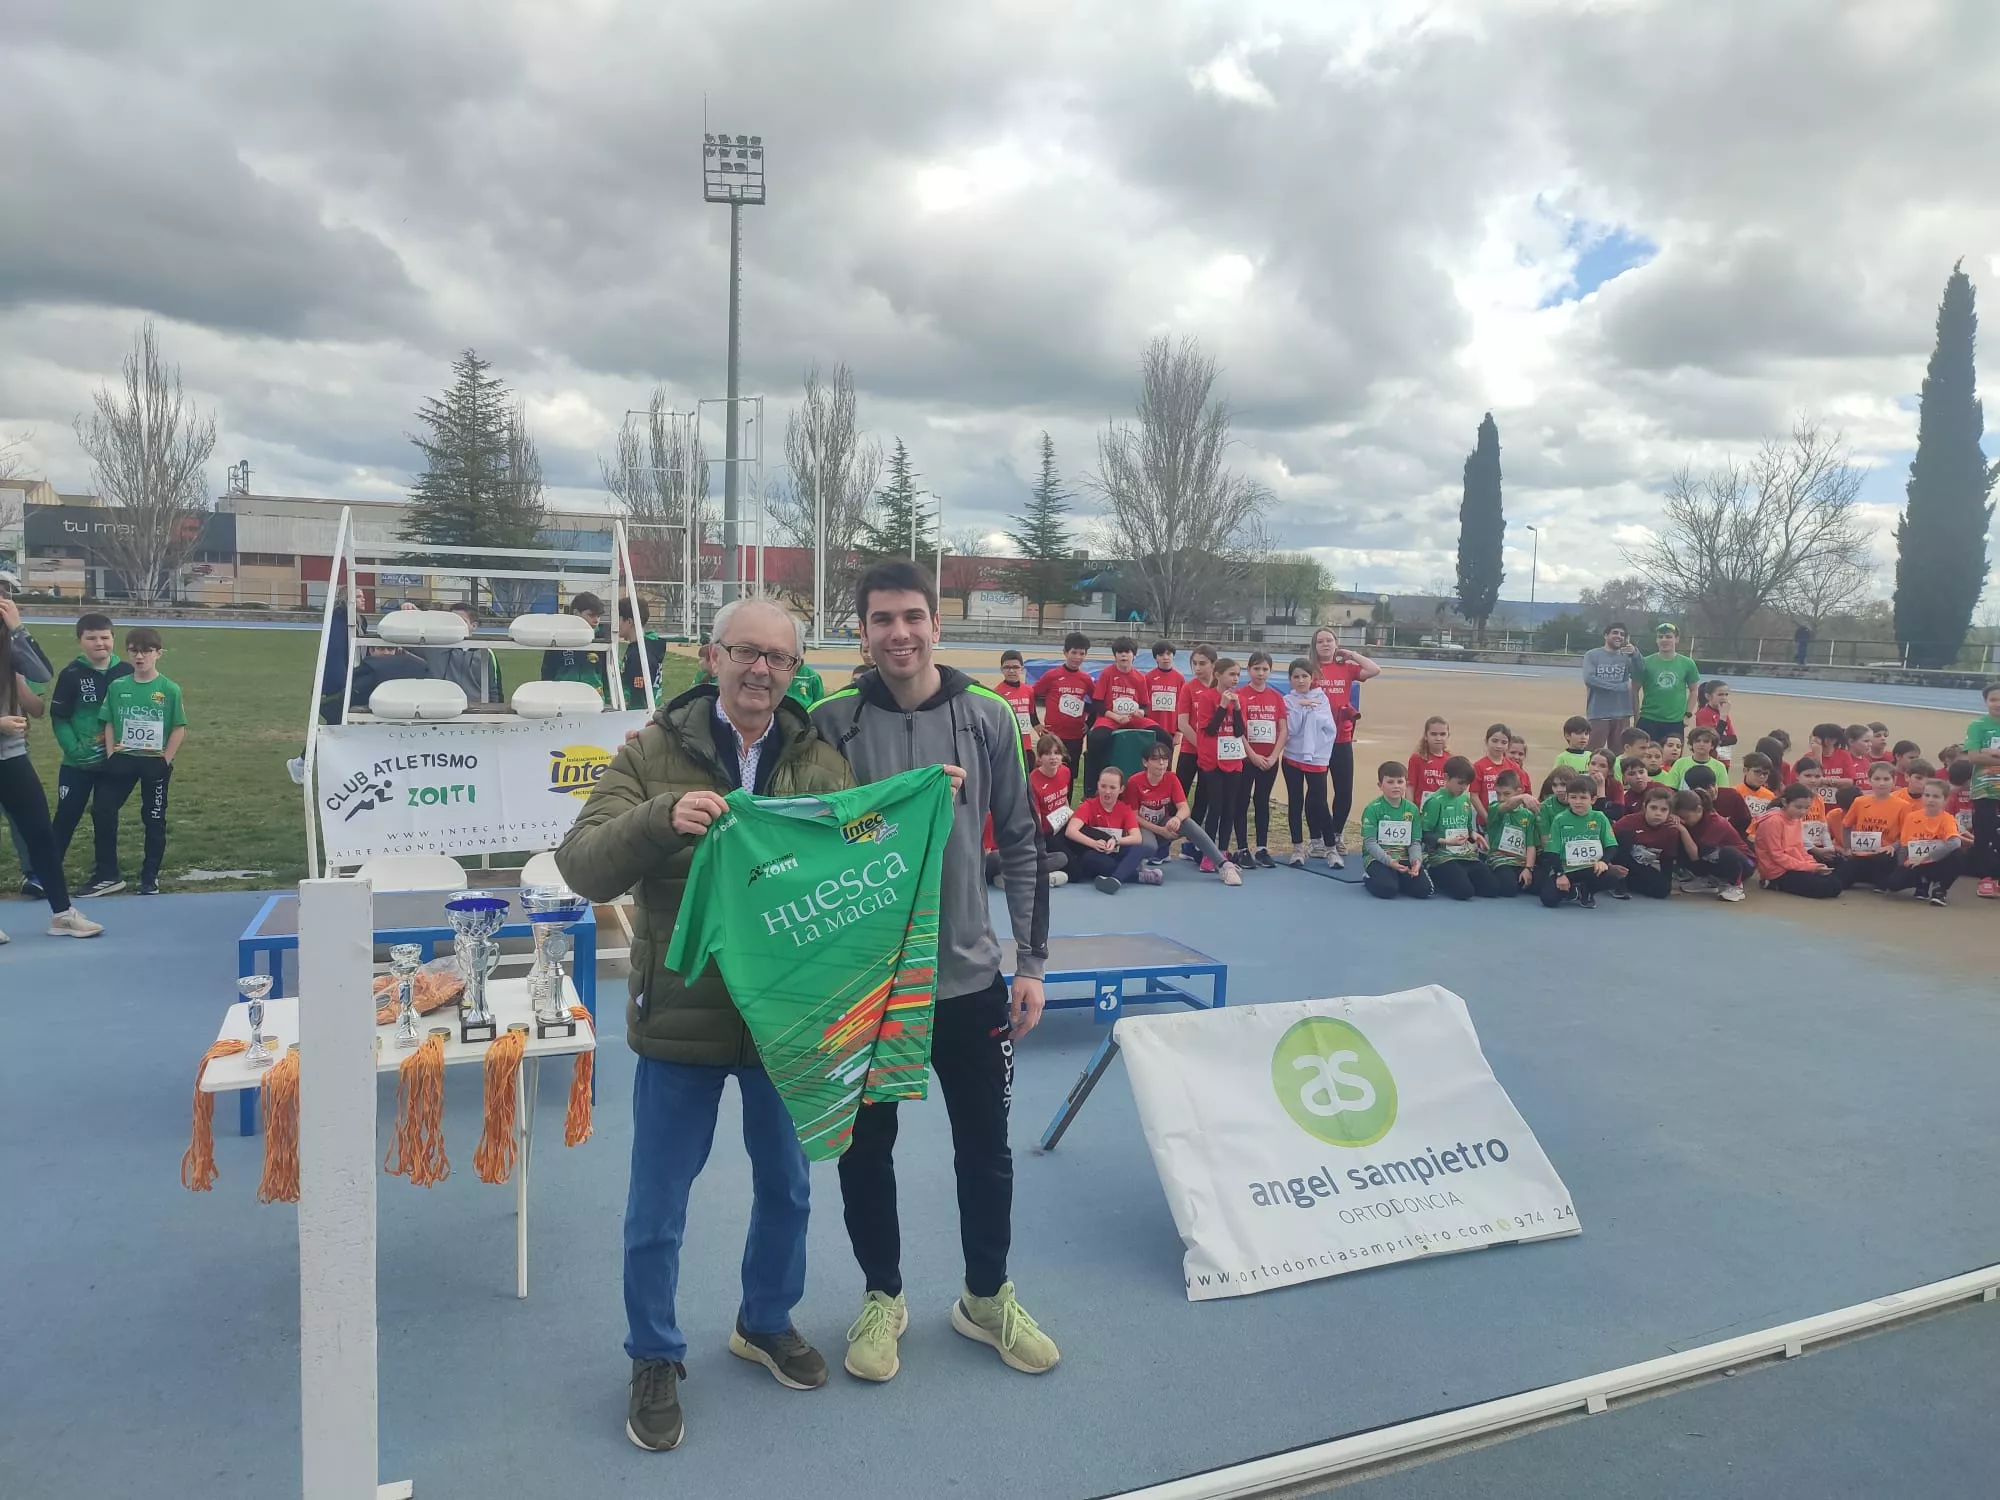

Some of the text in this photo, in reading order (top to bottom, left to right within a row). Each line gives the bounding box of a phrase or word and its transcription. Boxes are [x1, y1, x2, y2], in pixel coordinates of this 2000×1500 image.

[62, 519, 88, 532] tu
[1063, 699, 1080, 712] 609
[1118, 702, 1135, 712] 602
[1155, 697, 1173, 705] 600
[127, 727, 155, 740] 502
[1253, 726, 1272, 736] 594
[549, 751, 609, 783] Inte
[326, 753, 478, 811] CLUB ATLETISMO
[407, 784, 476, 807] ZOITI
[1819, 788, 1833, 798] 03
[1748, 801, 1767, 811] 459
[843, 813, 884, 840] Intec
[1384, 827, 1406, 838] 469
[336, 848, 373, 858] AIRE
[383, 836, 519, 854] ACONDICIONADO
[1571, 846, 1597, 858] 485
[1855, 837, 1876, 848] 447
[763, 857, 799, 878] ZOITI
[760, 851, 909, 936] Huesca
[1100, 985, 1118, 1011] 3
[1292, 1049, 1377, 1117] as
[1248, 1138, 1509, 1209] angel sampietro
[1338, 1191, 1465, 1224] ORTODONCIA
[1514, 1211, 1545, 1228] 974
[1553, 1204, 1574, 1221] 24
